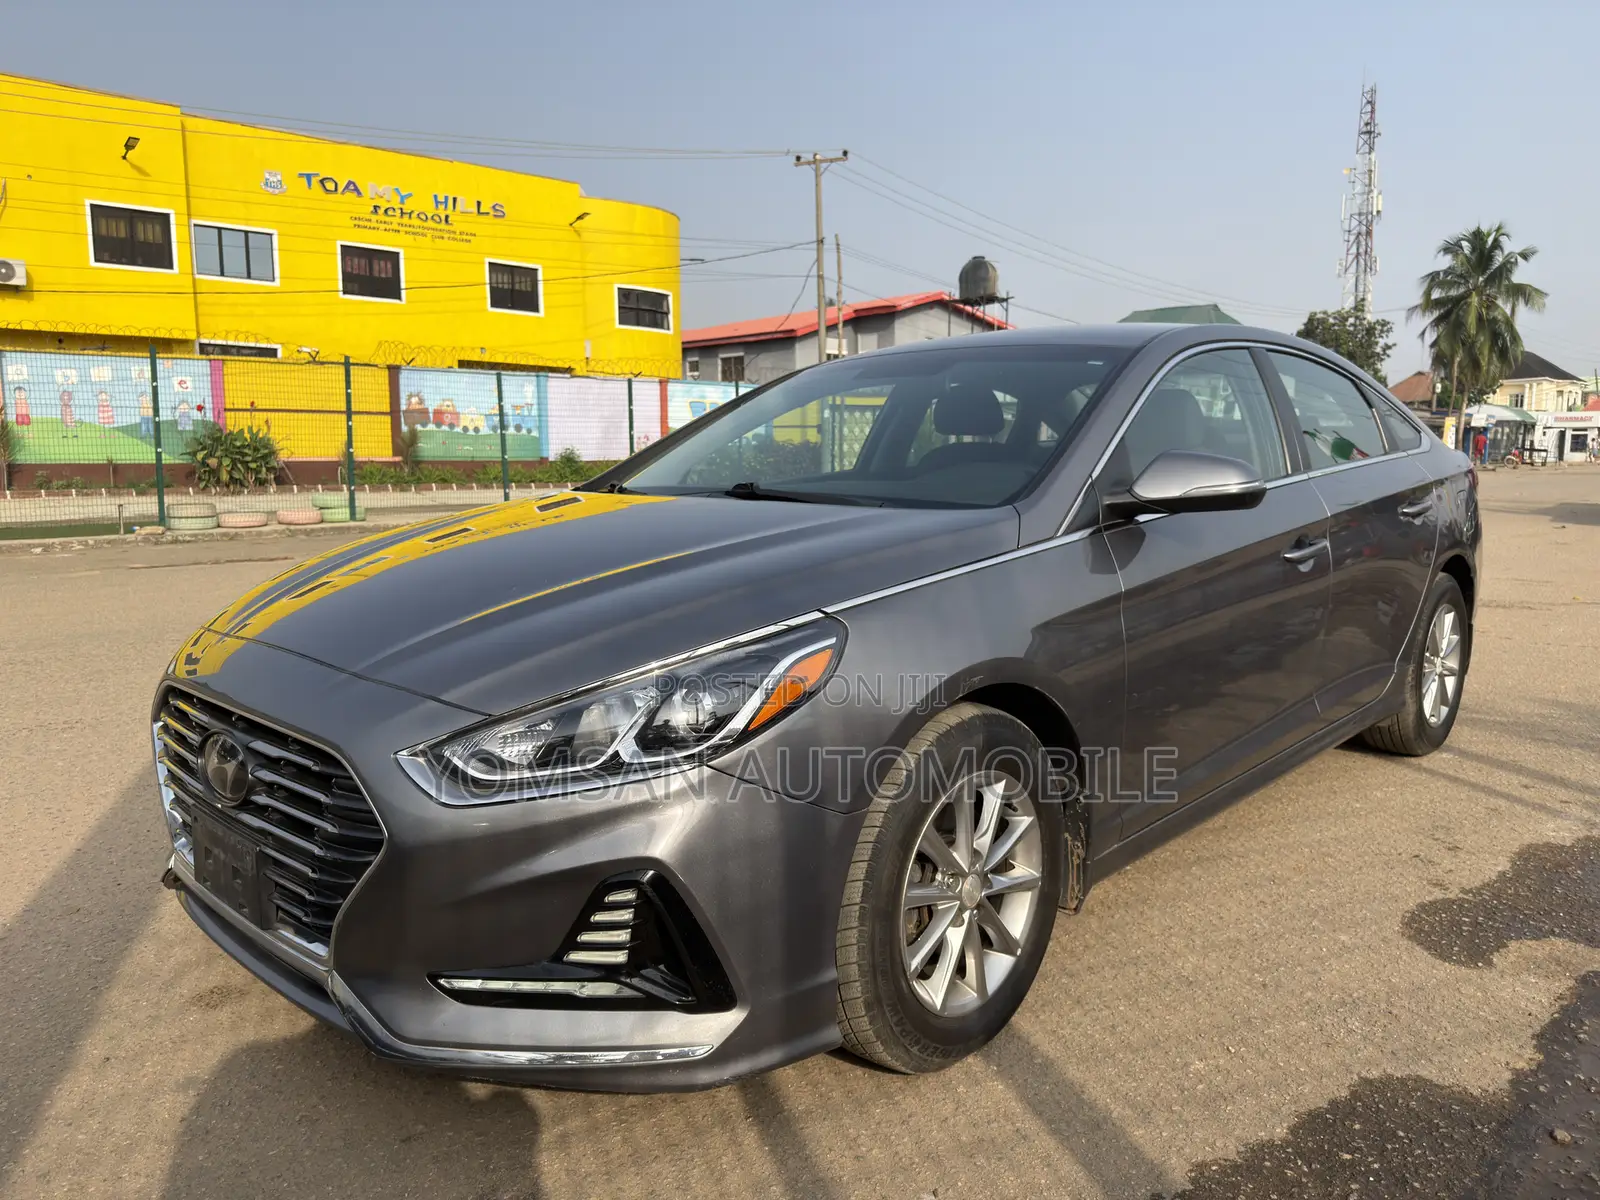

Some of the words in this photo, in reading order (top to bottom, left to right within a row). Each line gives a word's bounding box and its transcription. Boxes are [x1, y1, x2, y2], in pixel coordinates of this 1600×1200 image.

[298, 172, 413, 205] TOAMY
[433, 193, 506, 219] HILLS
[370, 204, 454, 226] SCHOOL
[404, 230, 428, 238] SCHOOL
[177, 378, 189, 390] e
